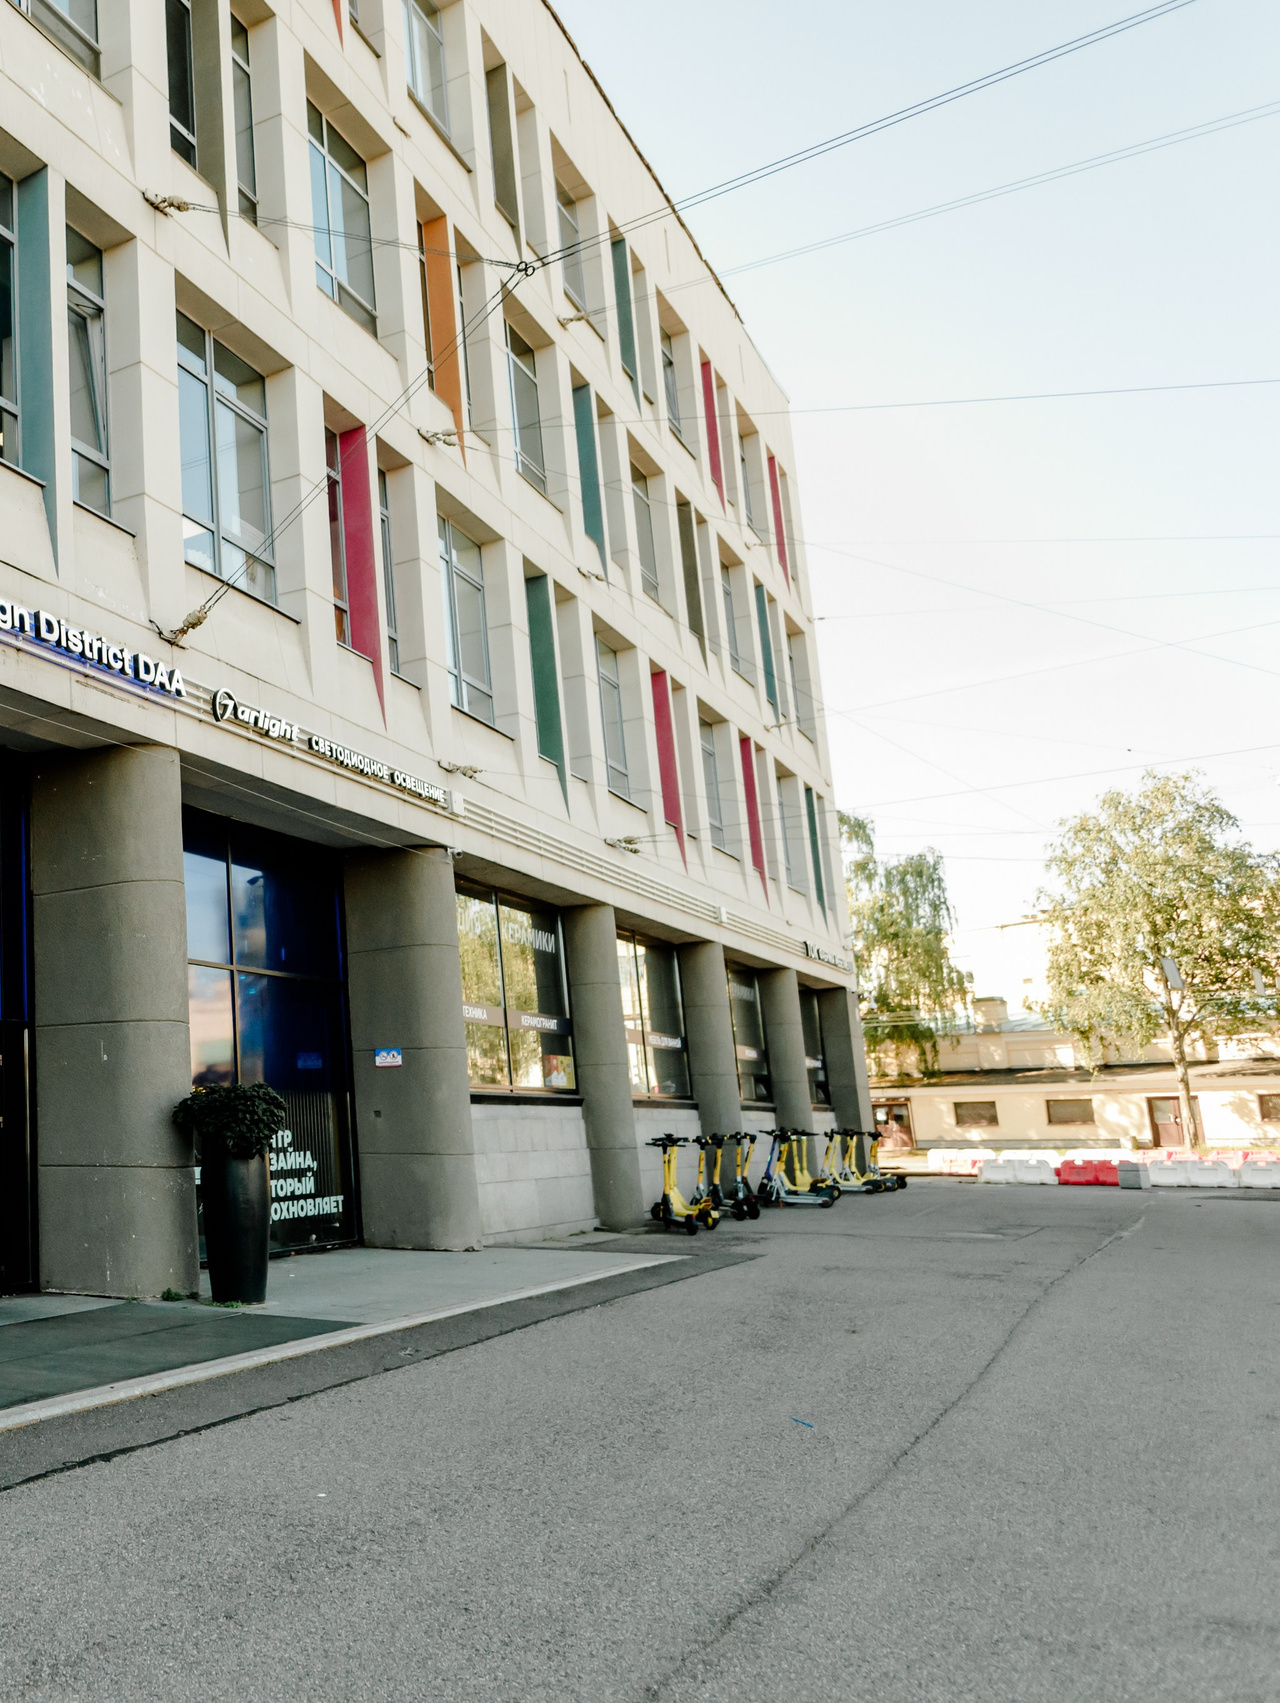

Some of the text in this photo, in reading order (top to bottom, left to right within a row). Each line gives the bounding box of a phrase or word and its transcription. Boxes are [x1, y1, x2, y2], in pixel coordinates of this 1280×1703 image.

[38, 610, 132, 675] District
[137, 653, 187, 698] DAA
[238, 706, 445, 802] arlight СВЕТОДИОДНОЕ ОСВЕЩЕНИЕ
[501, 920, 555, 953] КЕРАМИКИ
[270, 1172, 315, 1198] ТОРЫЙ
[270, 1195, 344, 1224] ОХНОВЛЯЕТ
